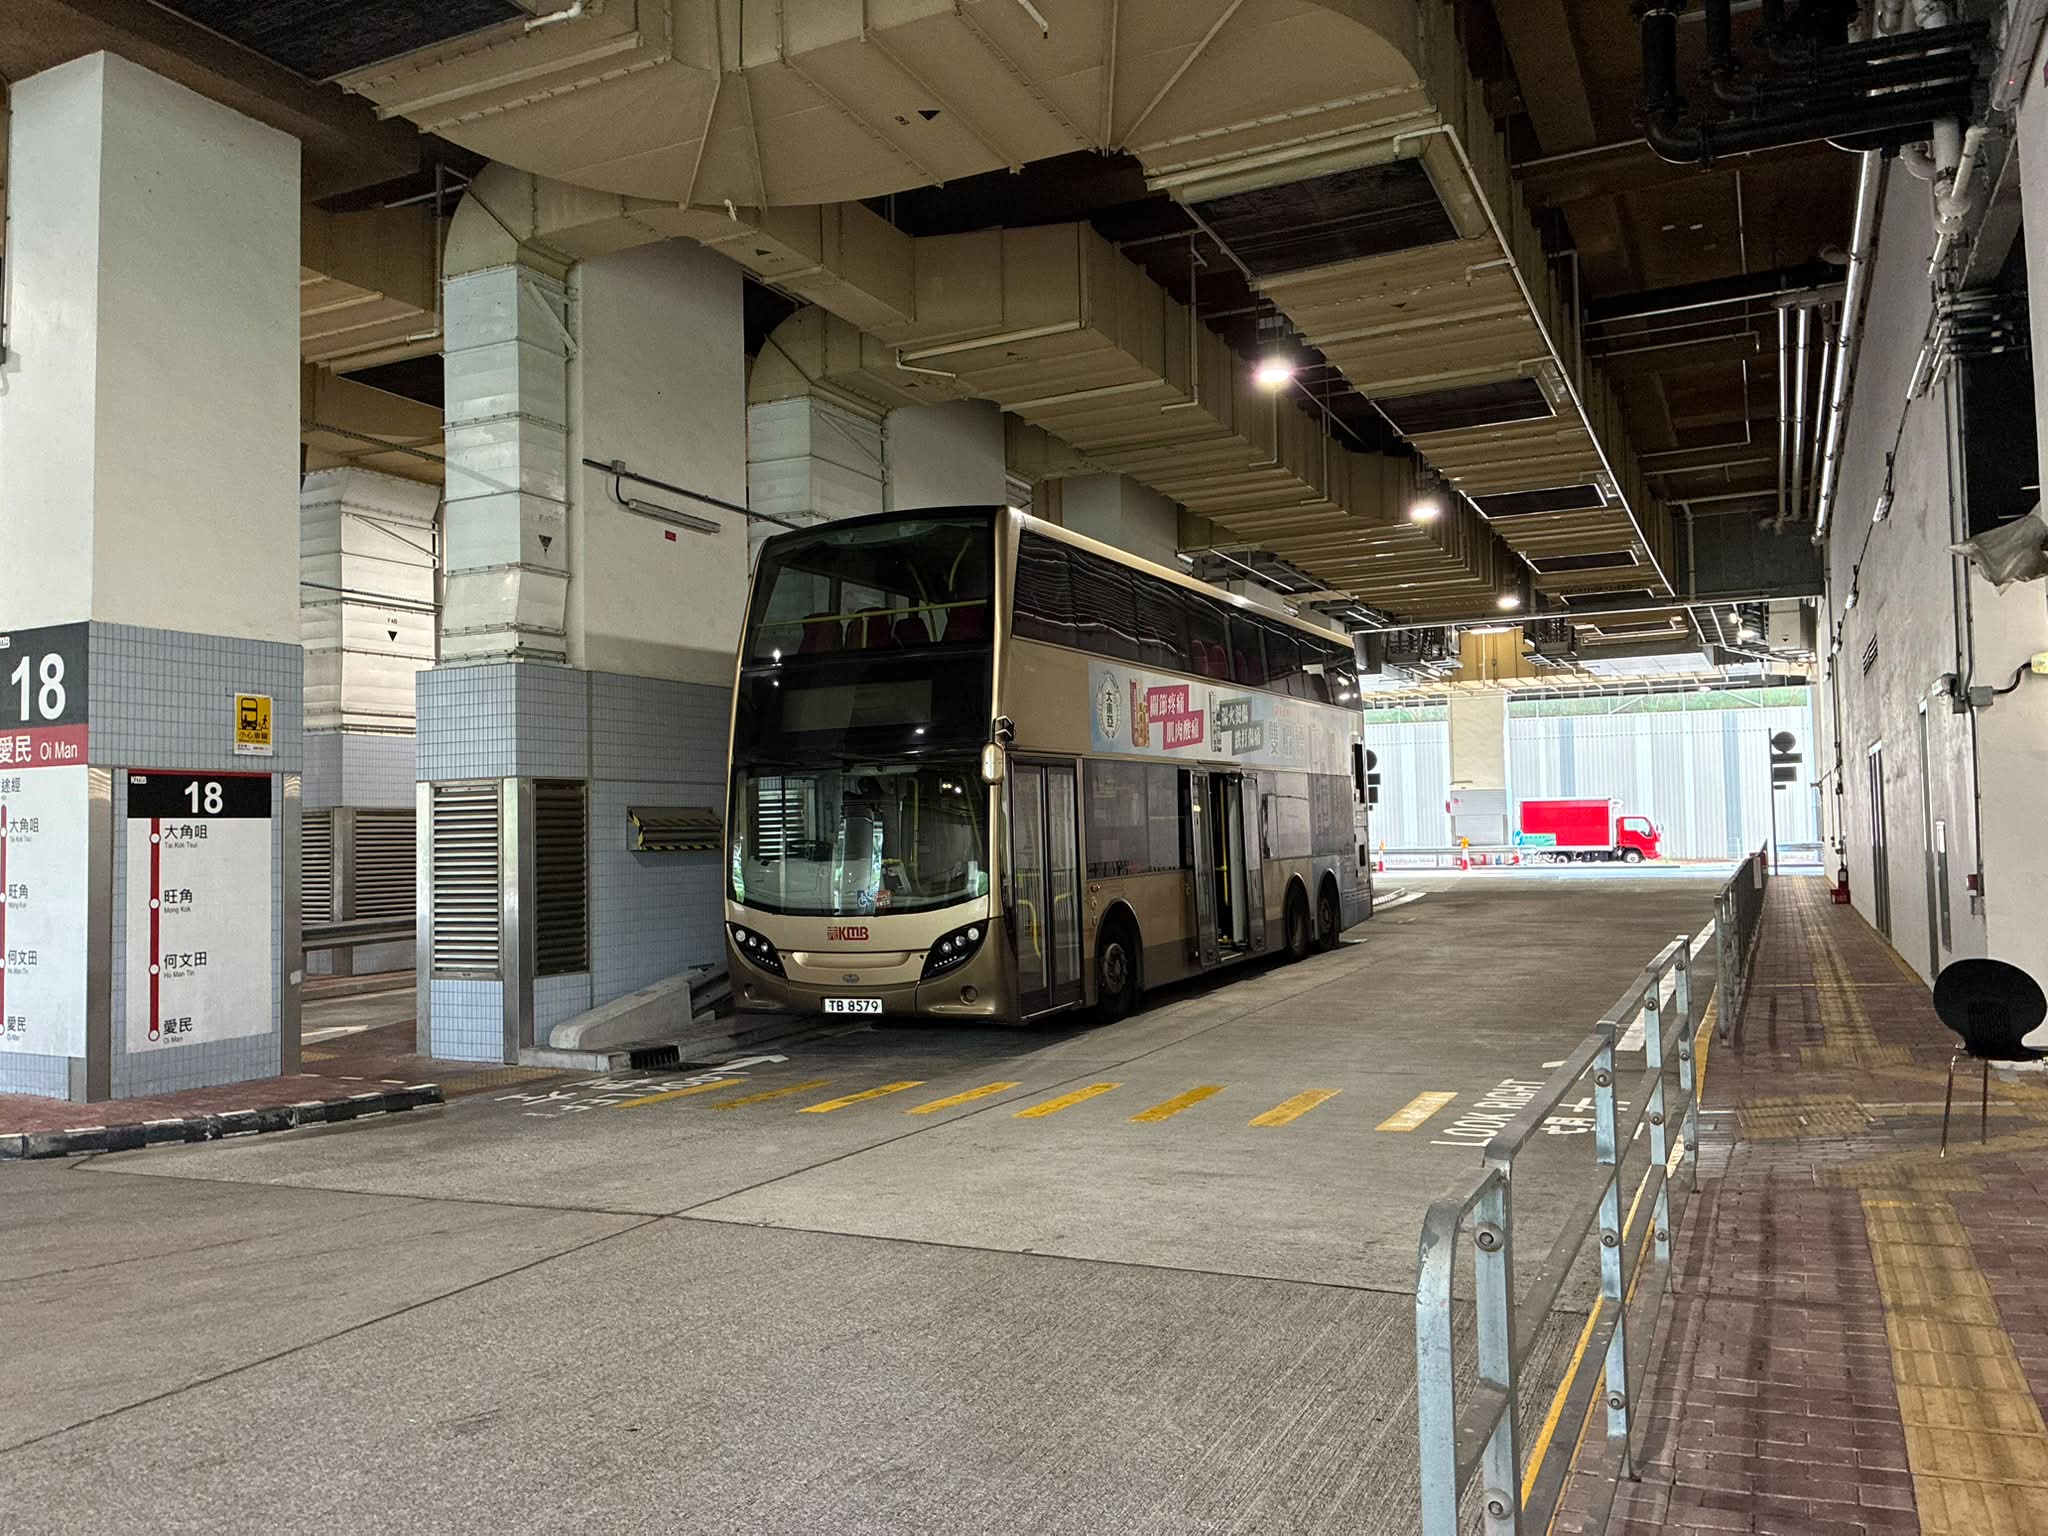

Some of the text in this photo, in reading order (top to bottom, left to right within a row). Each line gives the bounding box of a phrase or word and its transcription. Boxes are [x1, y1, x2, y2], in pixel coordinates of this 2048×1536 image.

[11, 652, 66, 722] 18
[1150, 691, 1184, 717] 關節疼痛
[0, 735, 32, 764] 愛民
[40, 741, 78, 761] Oi Man
[1, 777, 21, 793] 途經
[184, 781, 223, 814] 18
[9, 818, 39, 833] 大角咀
[164, 824, 207, 839] 大角咀
[165, 841, 173, 849] Tai
[8, 884, 28, 900] 旺角
[164, 889, 192, 904] 旺角
[838, 926, 869, 941] KMB
[8, 950, 37, 966] 何文田
[164, 952, 207, 969] 何文田
[829, 1000, 879, 1012] TB 8579
[7, 1016, 26, 1032] 愛民
[163, 1017, 192, 1035] 愛民
[634, 1071, 751, 1092] LOOK
[1430, 1078, 1546, 1147] LOOK RIGHT
